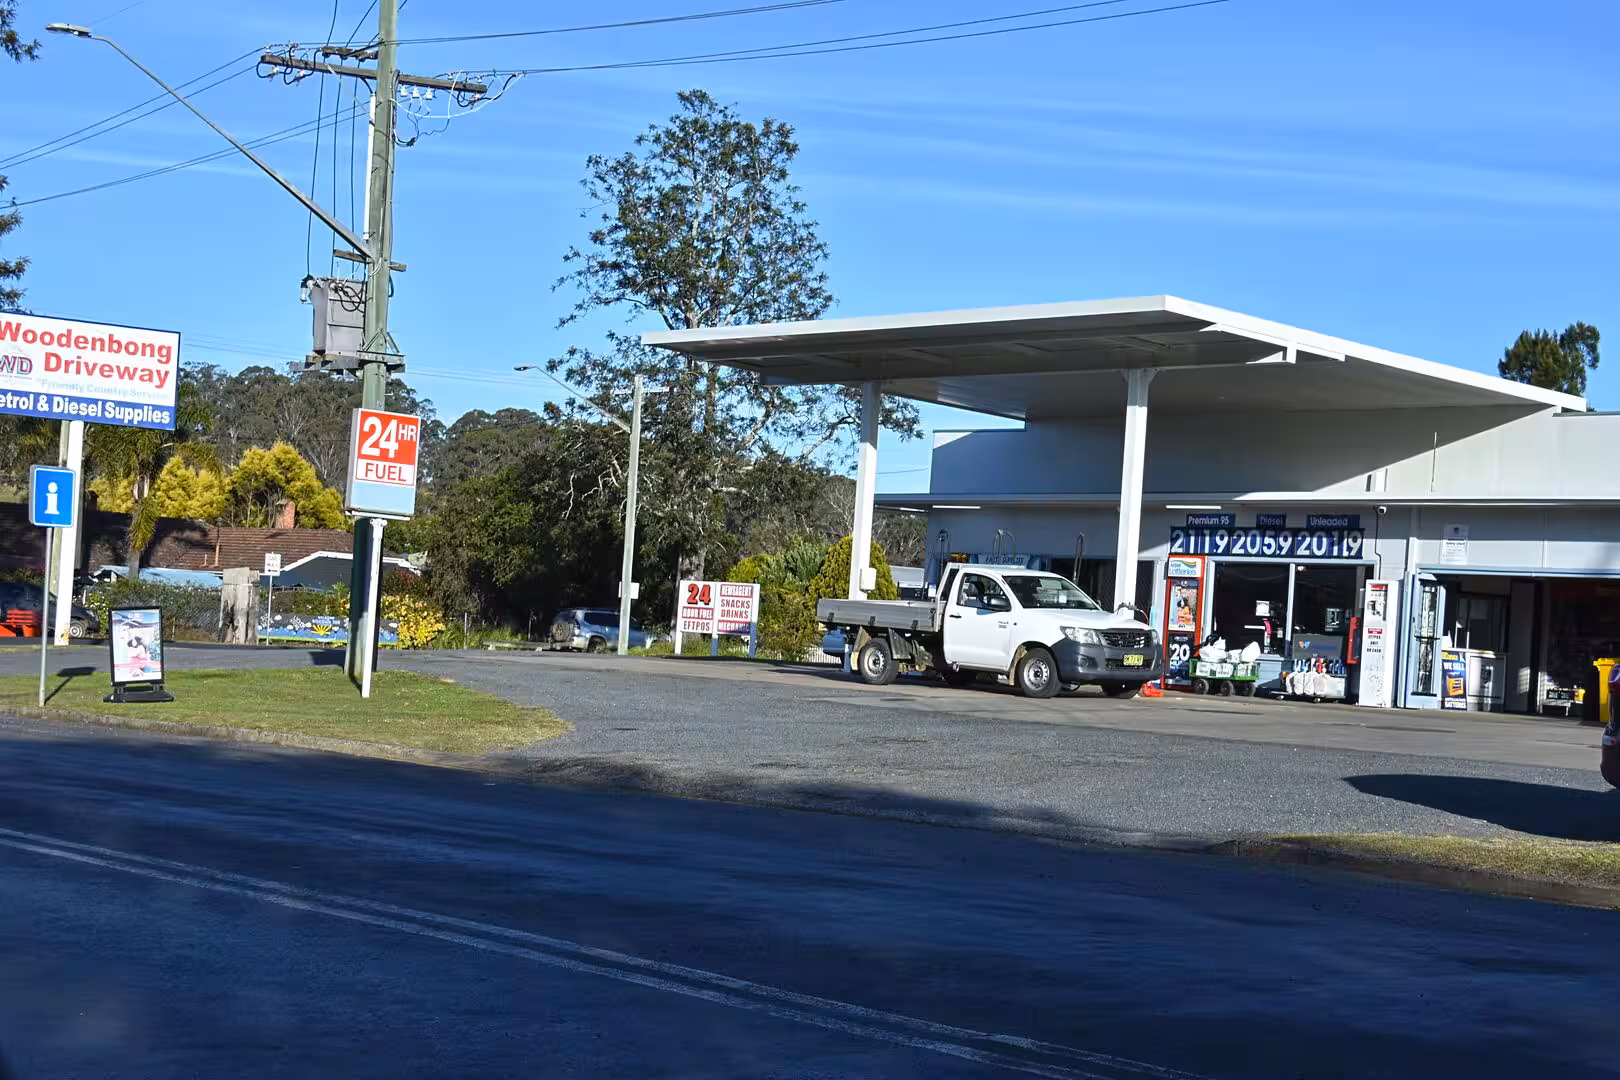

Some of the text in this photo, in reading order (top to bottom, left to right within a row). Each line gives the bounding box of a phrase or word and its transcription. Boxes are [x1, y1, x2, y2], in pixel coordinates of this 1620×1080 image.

[0, 320, 172, 365] Woodenbong
[44, 351, 170, 389] Driveway
[0, 393, 170, 425] etrol & Diesel Supplies
[361, 415, 417, 459] 24 HR
[365, 461, 407, 482] FUEL
[1188, 515, 1230, 525] Premium 95
[1260, 515, 1283, 525] Diesel
[1310, 516, 1348, 526] Unleaded
[687, 583, 711, 606] 24
[720, 599, 751, 609] SNACKS
[682, 607, 713, 620] HOUR FUEL
[720, 609, 749, 620] DRINKS
[683, 621, 710, 632] EFTPOS
